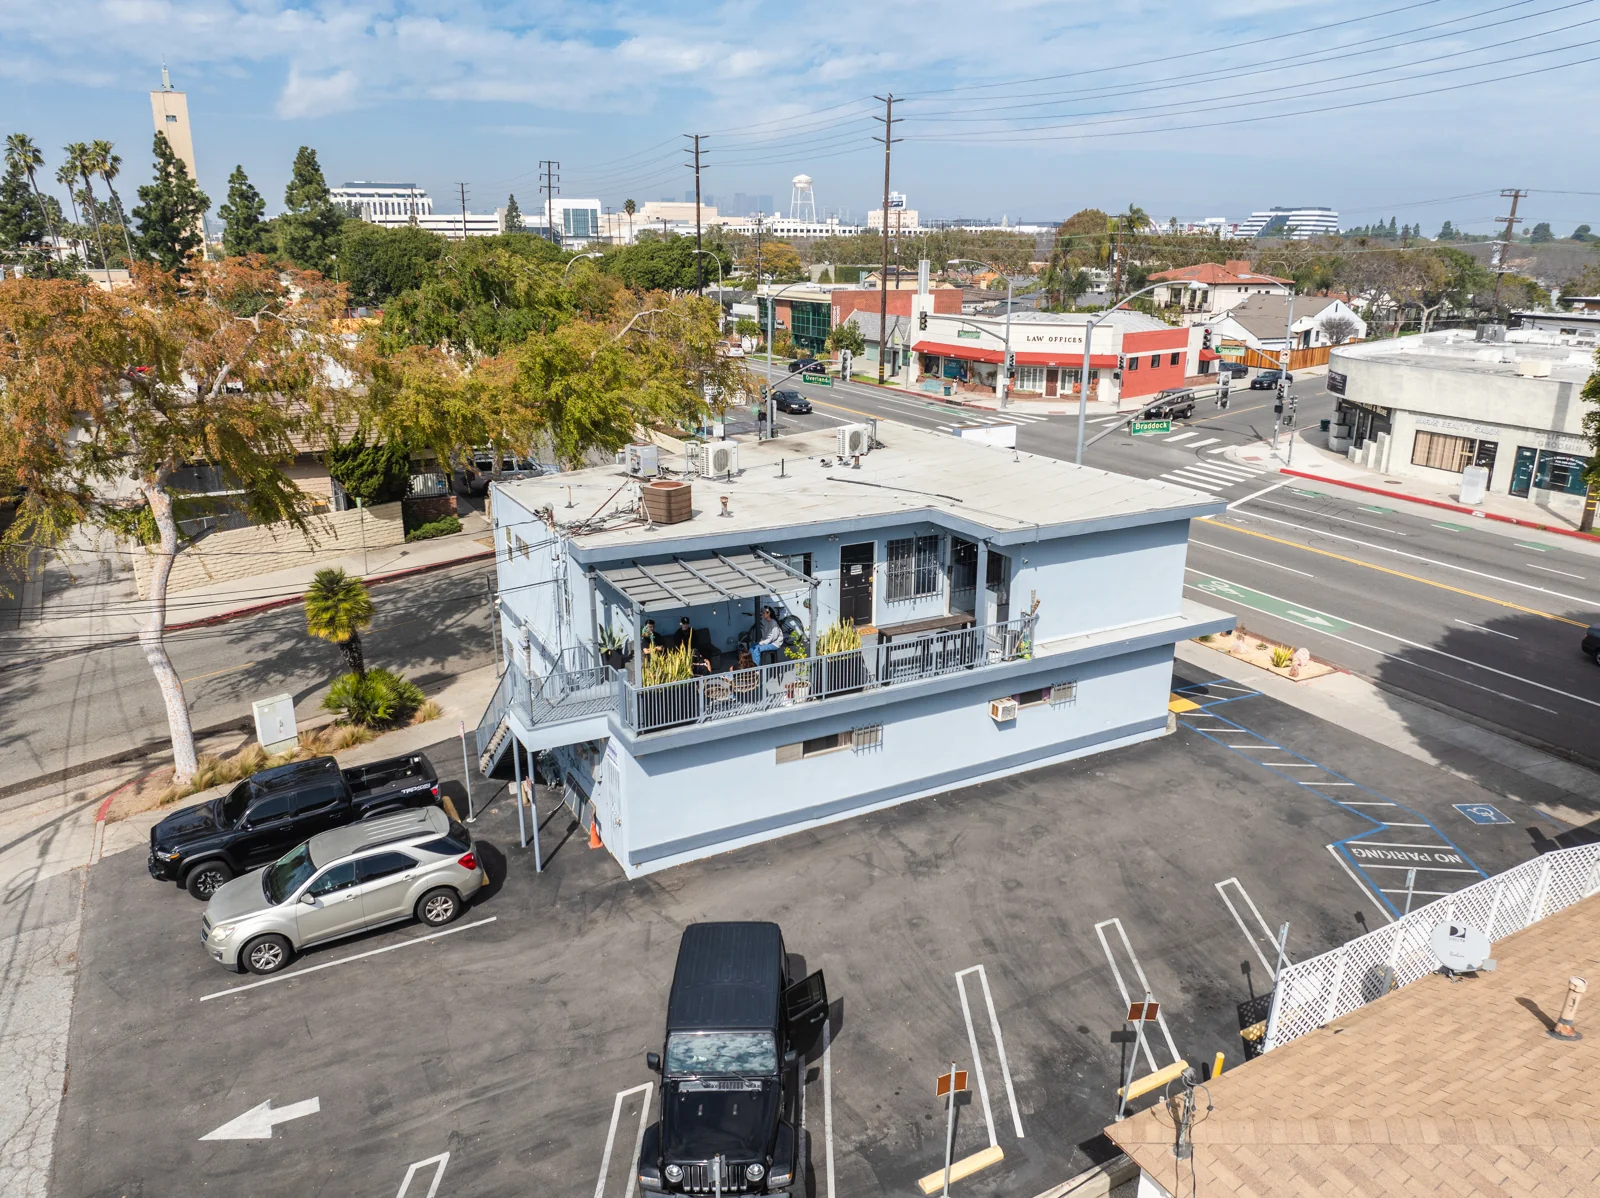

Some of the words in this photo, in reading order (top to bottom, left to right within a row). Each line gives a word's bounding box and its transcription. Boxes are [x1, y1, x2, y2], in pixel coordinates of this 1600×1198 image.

[1135, 421, 1167, 430] Braddock
[1351, 848, 1433, 862] PARKING
[1434, 853, 1463, 864] NO
